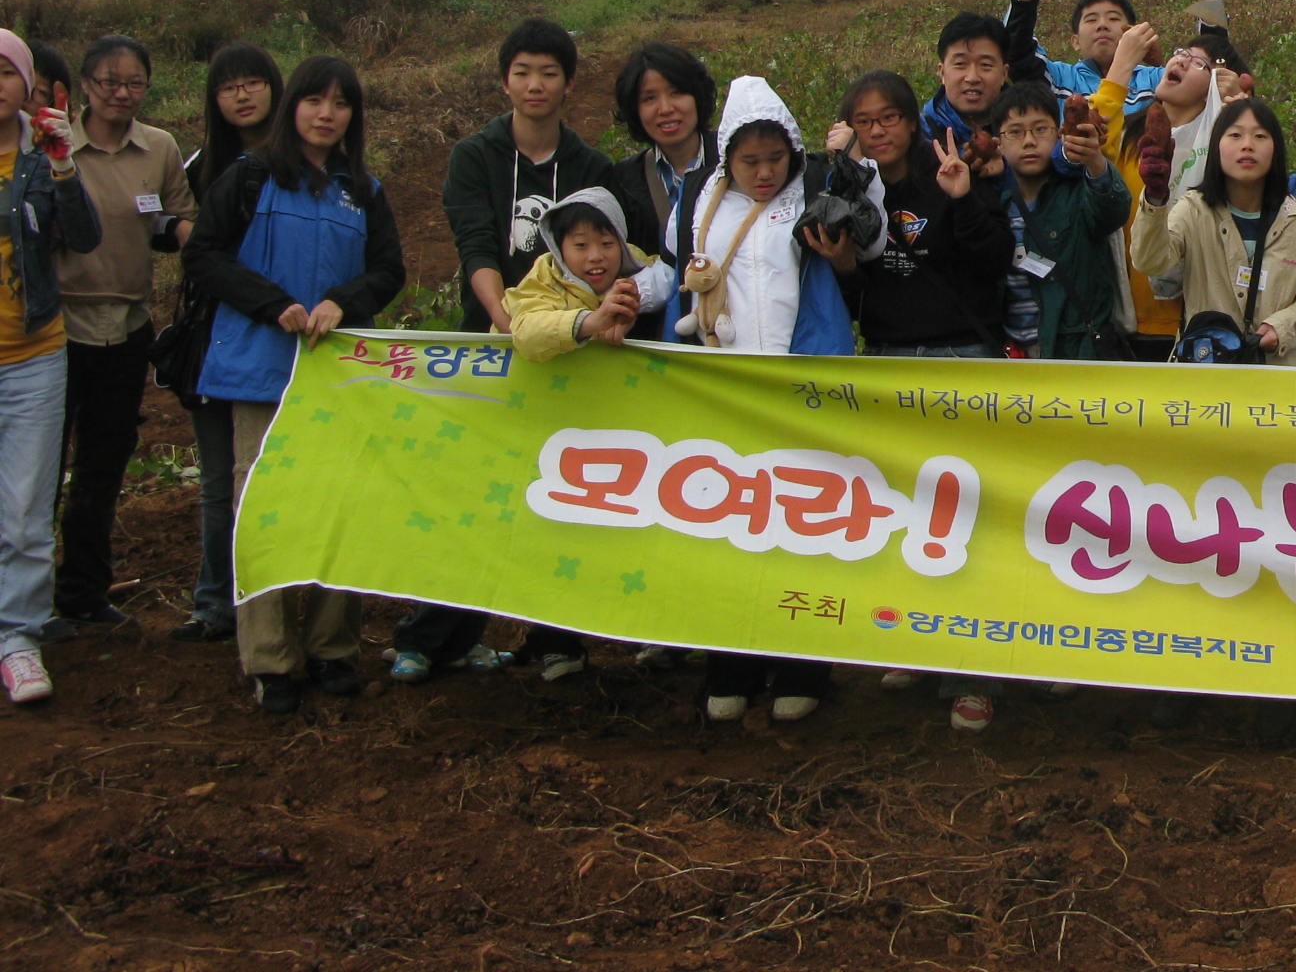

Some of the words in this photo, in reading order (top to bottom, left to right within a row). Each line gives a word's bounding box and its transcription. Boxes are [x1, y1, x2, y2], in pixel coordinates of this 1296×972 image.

[1163, 400, 1231, 426] 함께
[549, 448, 959, 558] 모여라!
[778, 590, 846, 624] 주최
[907, 612, 1275, 664] 양천장애인종합복지관
